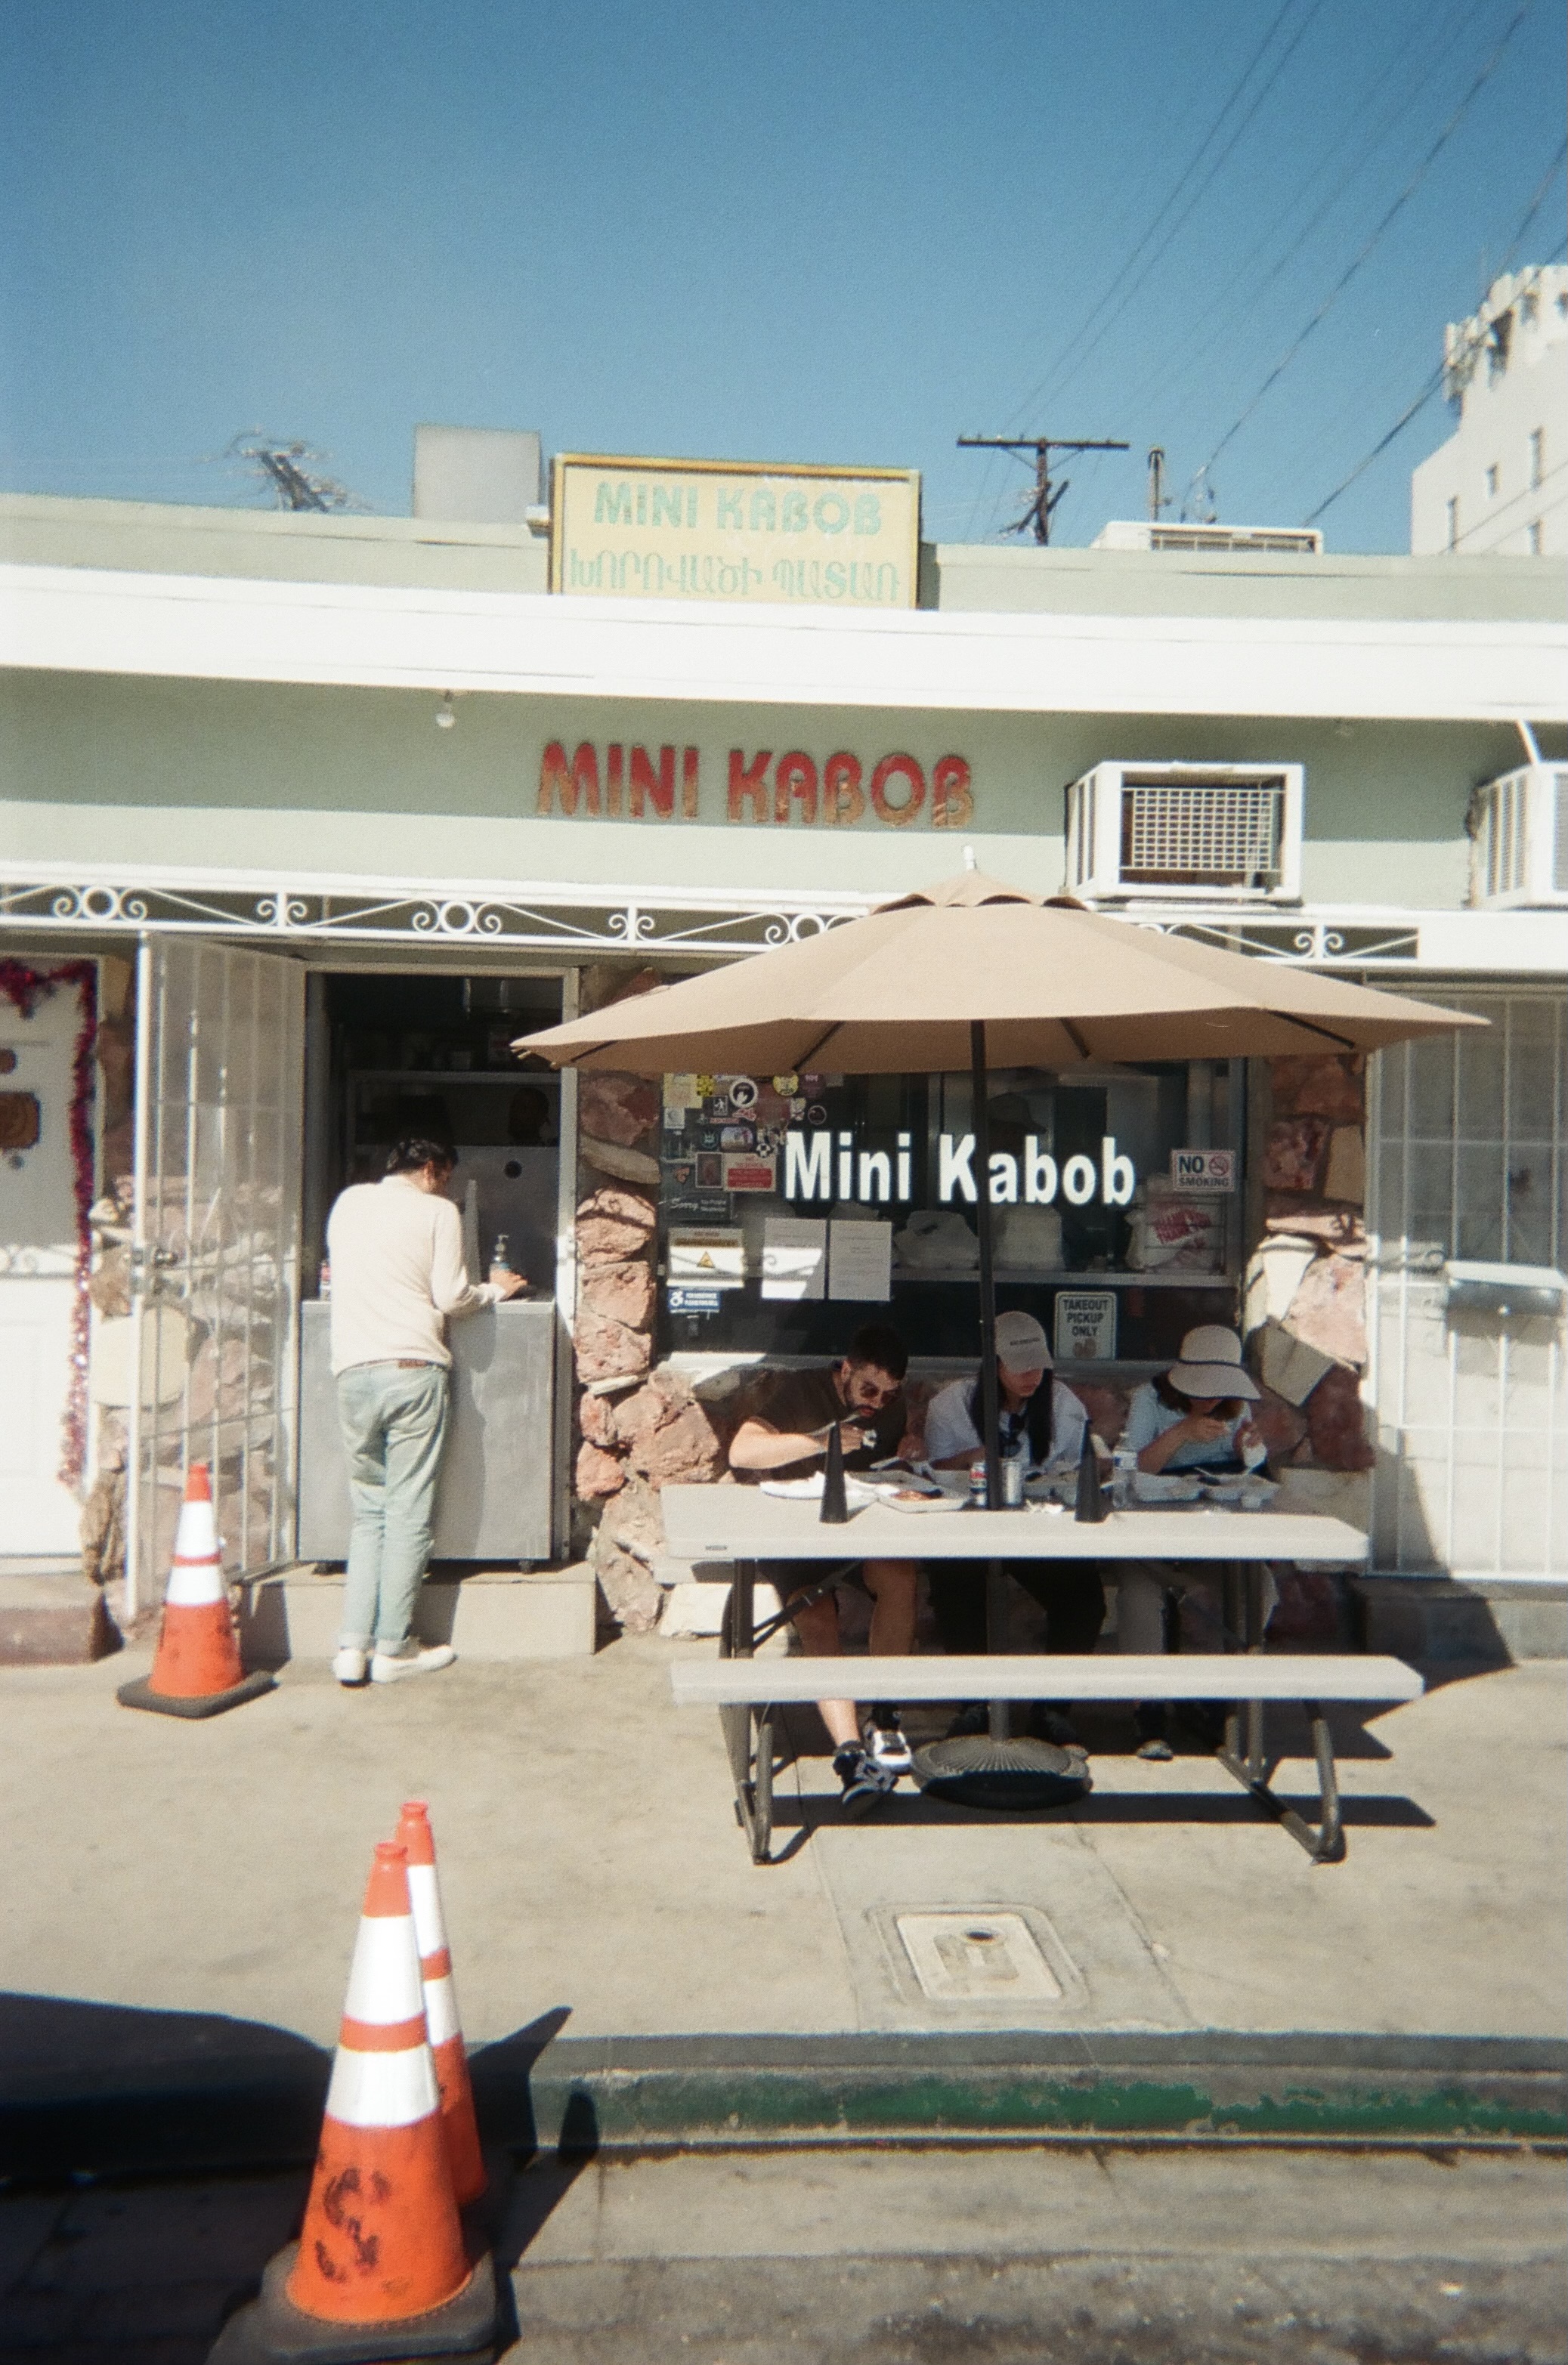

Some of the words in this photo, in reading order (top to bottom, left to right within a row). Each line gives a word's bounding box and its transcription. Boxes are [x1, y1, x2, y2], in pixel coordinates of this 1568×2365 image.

[593, 481, 699, 529] MINI
[716, 487, 883, 536] KABOB
[537, 741, 699, 819] MINI
[727, 749, 974, 828] KABOB
[785, 1132, 910, 1201] Mini
[939, 1133, 1134, 1205] Kabob
[1179, 1155, 1204, 1173] NO
[1179, 1177, 1229, 1187] SMOKING
[1062, 1300, 1109, 1311] TAKEOUT
[1067, 1312, 1104, 1324] PICKUP
[1072, 1326, 1098, 1337] ONLY
